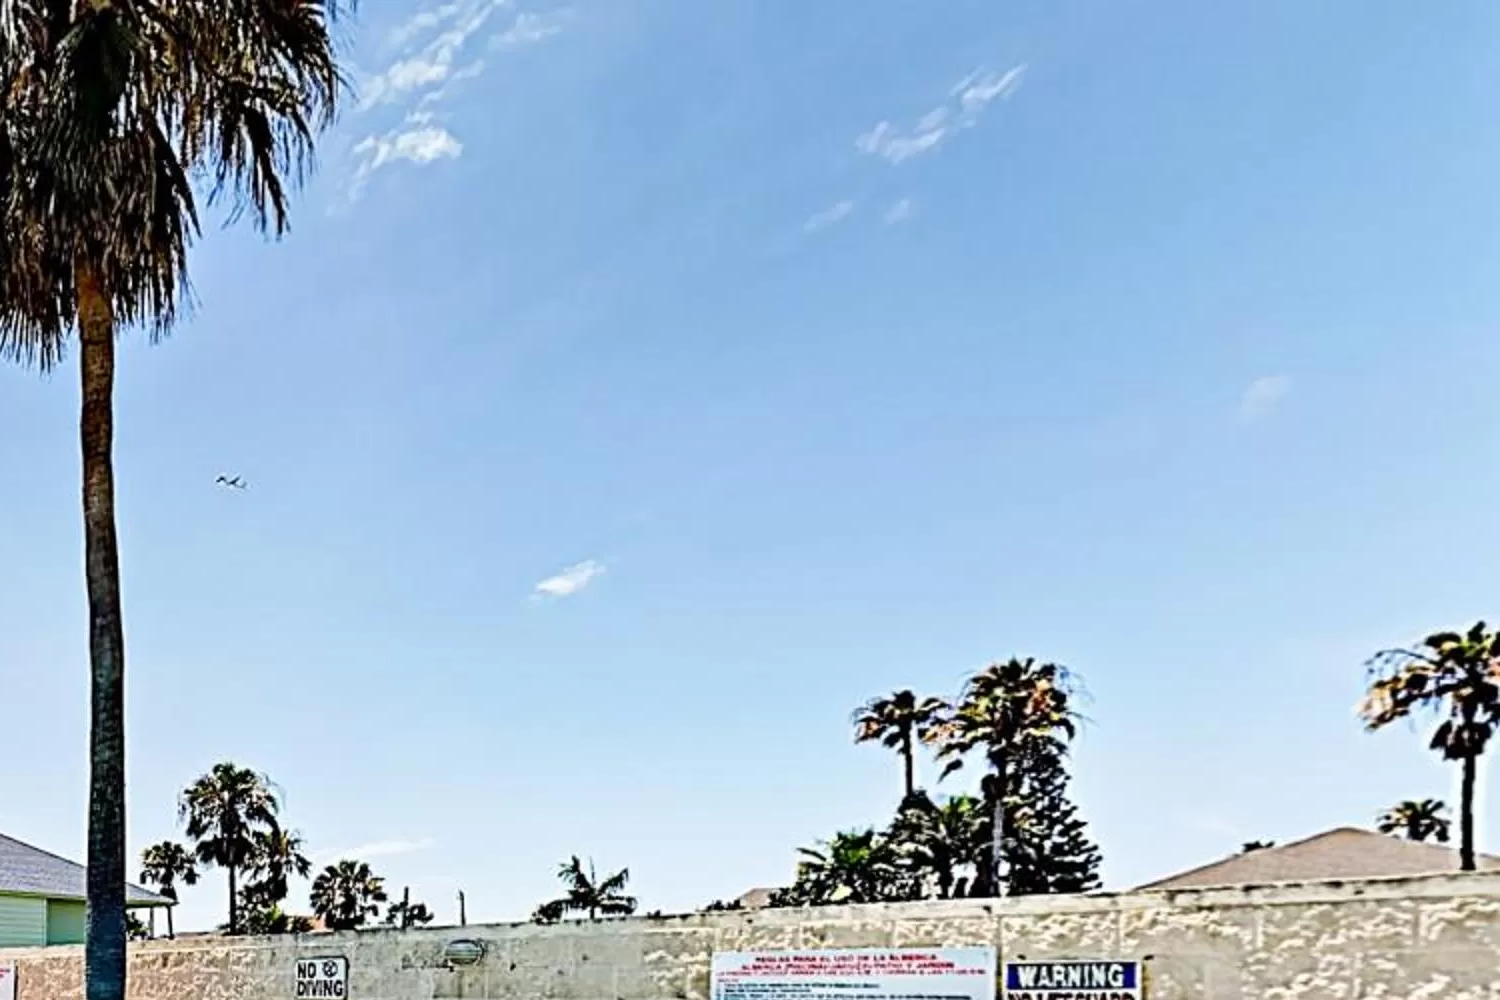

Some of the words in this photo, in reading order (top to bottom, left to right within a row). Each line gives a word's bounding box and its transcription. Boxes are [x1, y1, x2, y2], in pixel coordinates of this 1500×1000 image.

[297, 962, 317, 978] NO
[1017, 964, 1125, 988] WARNING
[297, 979, 343, 996] DIVING
